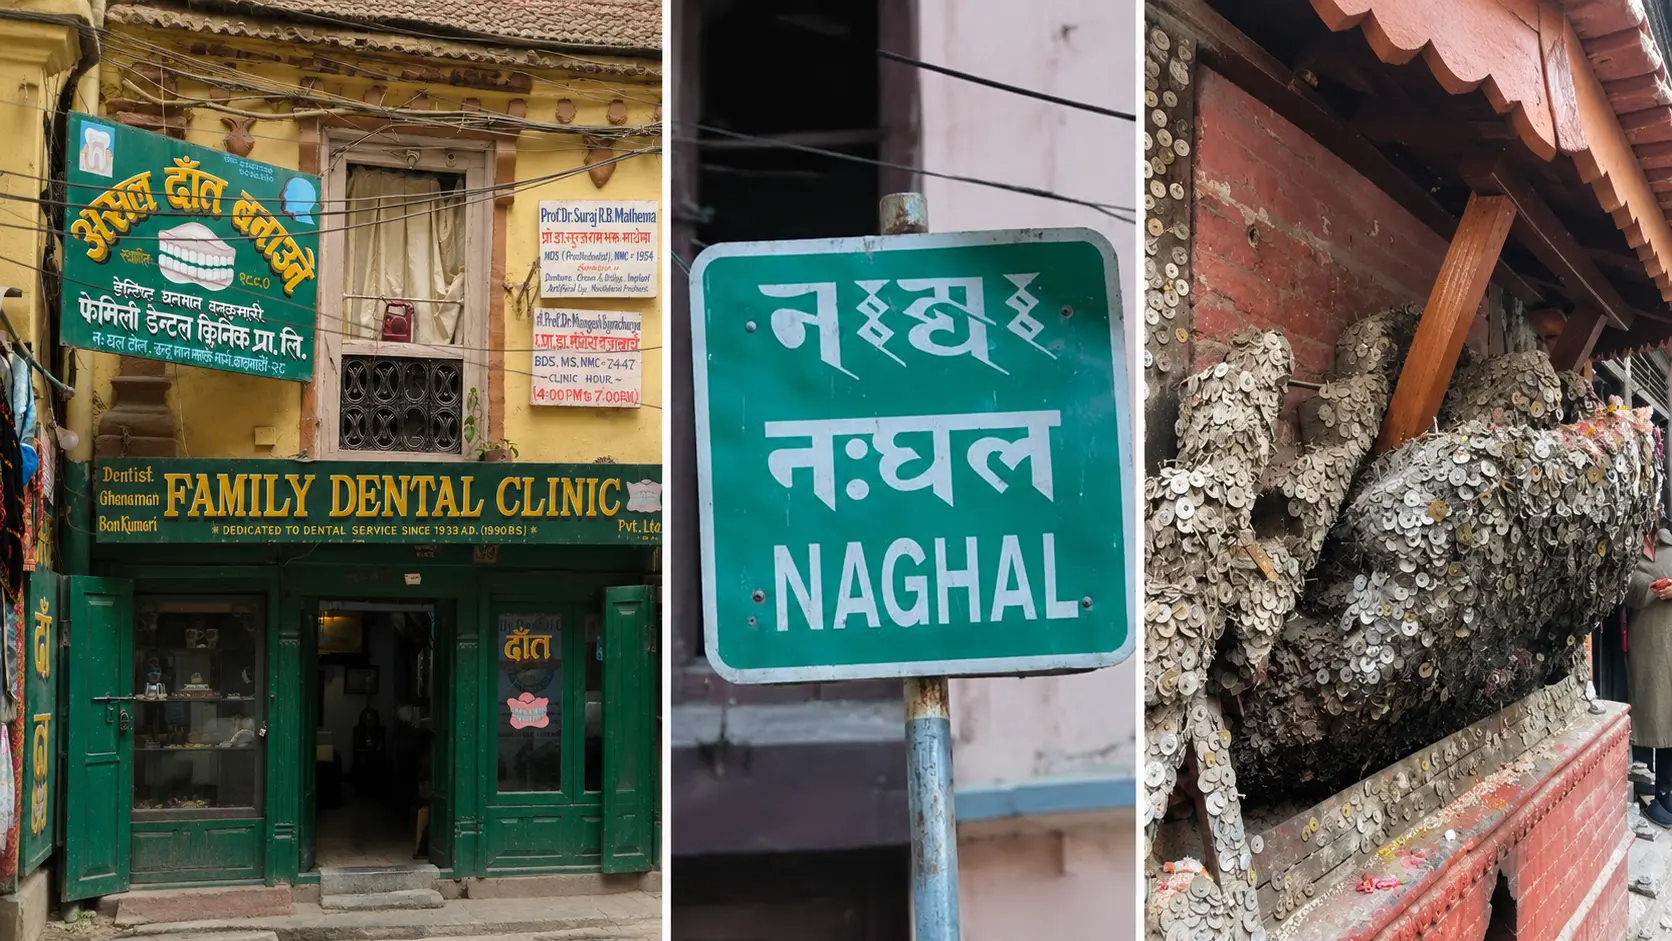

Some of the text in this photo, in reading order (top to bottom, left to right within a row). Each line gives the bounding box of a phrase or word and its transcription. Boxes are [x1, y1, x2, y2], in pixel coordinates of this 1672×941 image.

[164, 156, 228, 214] दाँत
[585, 374, 612, 384] HOUR
[164, 473, 621, 518] FAMILY DENTAL CLINIC
[222, 525, 282, 536] DEDICATED
[285, 525, 300, 535] TO
[303, 525, 347, 536] DENTAL
[351, 525, 397, 536] SERVICE
[401, 525, 431, 535] SINCE
[434, 525, 459, 535] 1933
[773, 533, 1079, 632] NAGHAL
[504, 626, 552, 662] दाँत
